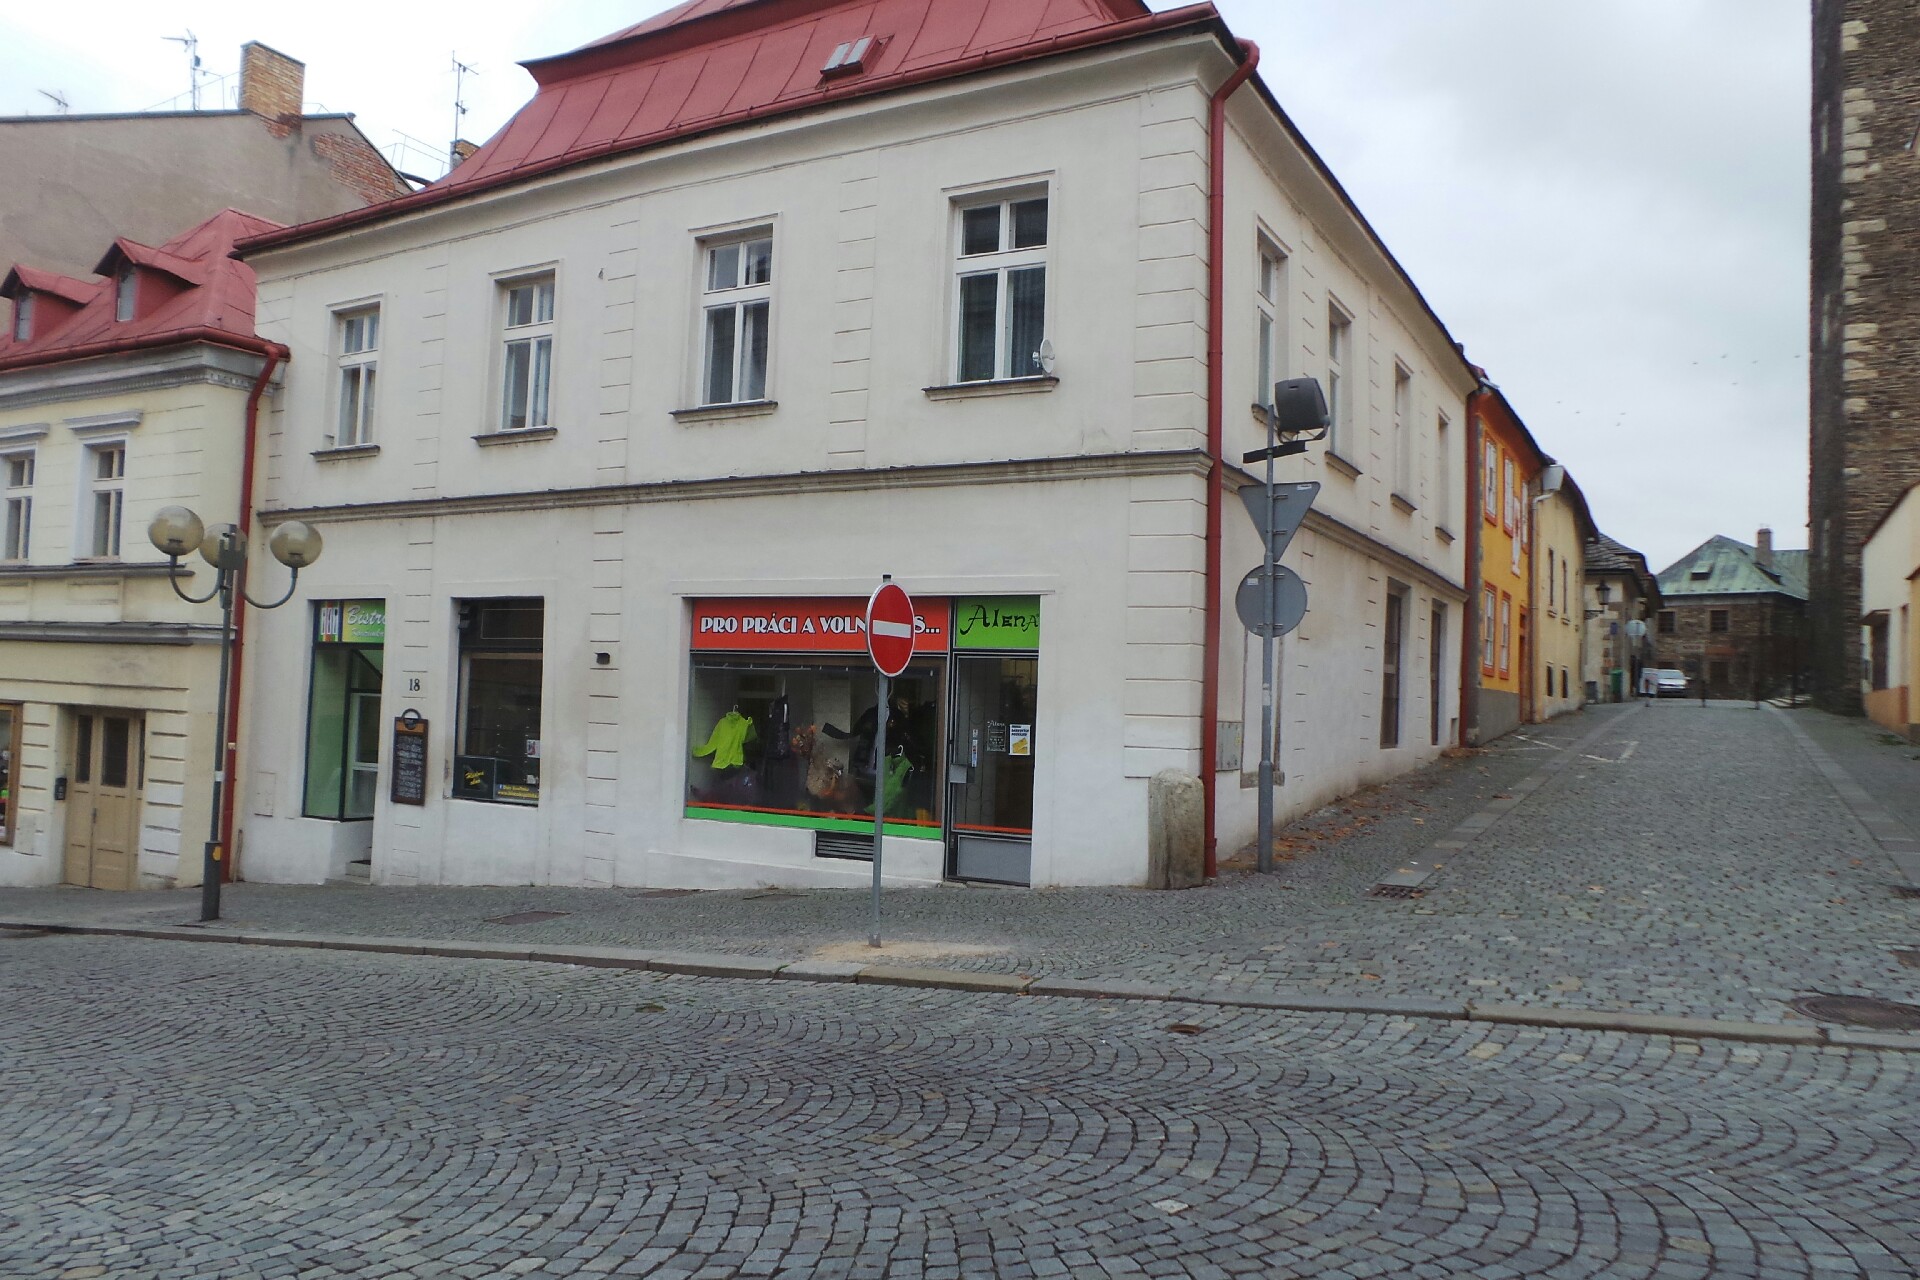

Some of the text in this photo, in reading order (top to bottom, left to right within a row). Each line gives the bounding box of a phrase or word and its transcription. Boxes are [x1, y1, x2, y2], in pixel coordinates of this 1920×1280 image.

[700, 612, 940, 634] PRO PRÁCI A VOLN S...
[409, 678, 421, 692] 18
